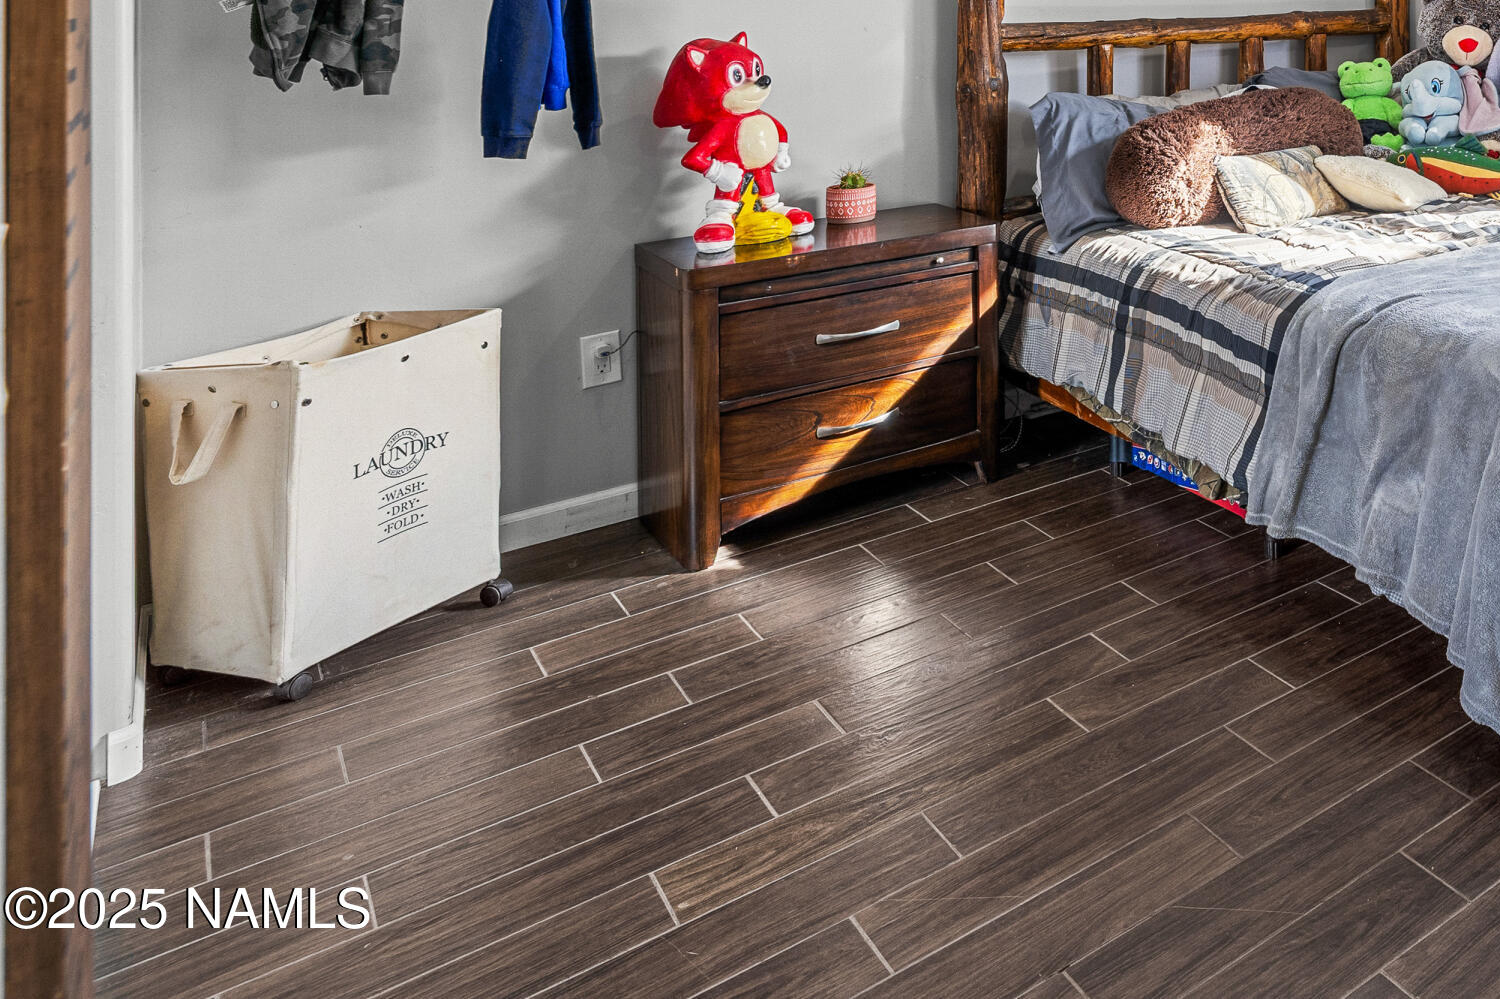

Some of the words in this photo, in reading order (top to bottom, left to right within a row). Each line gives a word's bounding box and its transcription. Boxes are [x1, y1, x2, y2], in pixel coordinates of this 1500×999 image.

[387, 430, 418, 447] DELUXE
[353, 431, 450, 479] LAUNDRY
[386, 458, 420, 476] SERVICE
[385, 481, 421, 501] WASH
[391, 498, 417, 516] DRY
[386, 513, 419, 533] FOLD
